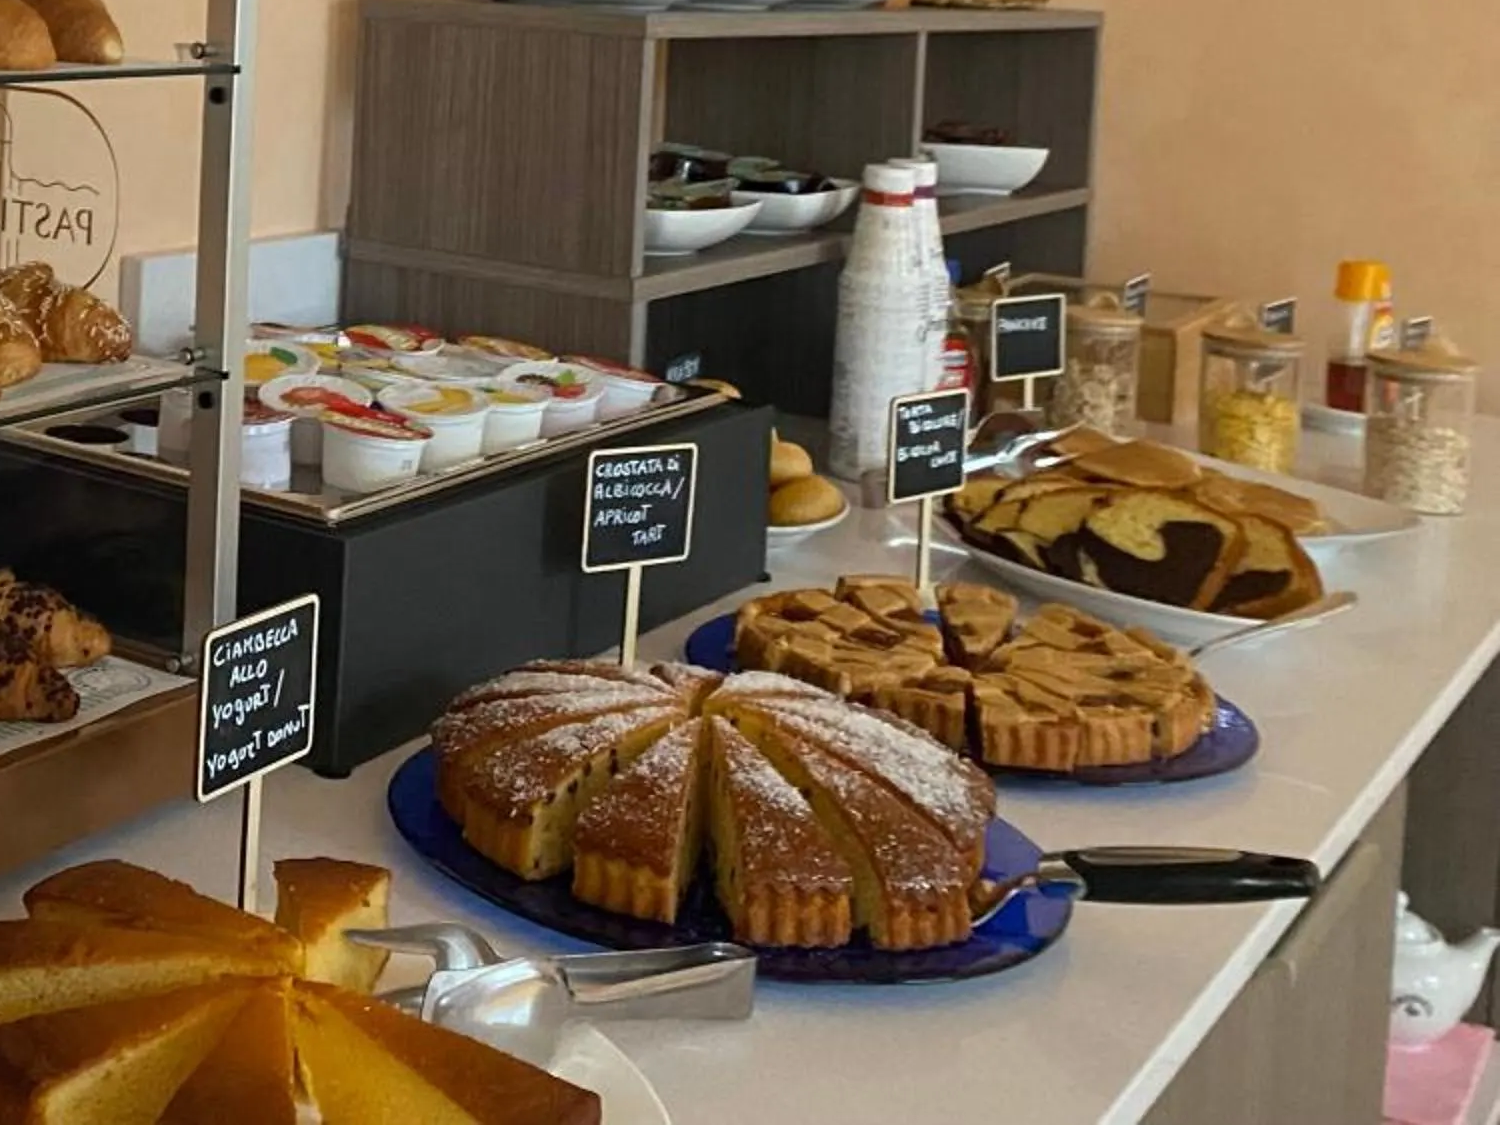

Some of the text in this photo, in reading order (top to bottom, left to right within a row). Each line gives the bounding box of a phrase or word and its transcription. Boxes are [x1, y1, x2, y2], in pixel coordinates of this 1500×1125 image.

[595, 458, 663, 478] CROSTATA
[631, 524, 667, 546] TART
[229, 659, 269, 688] ALLO
